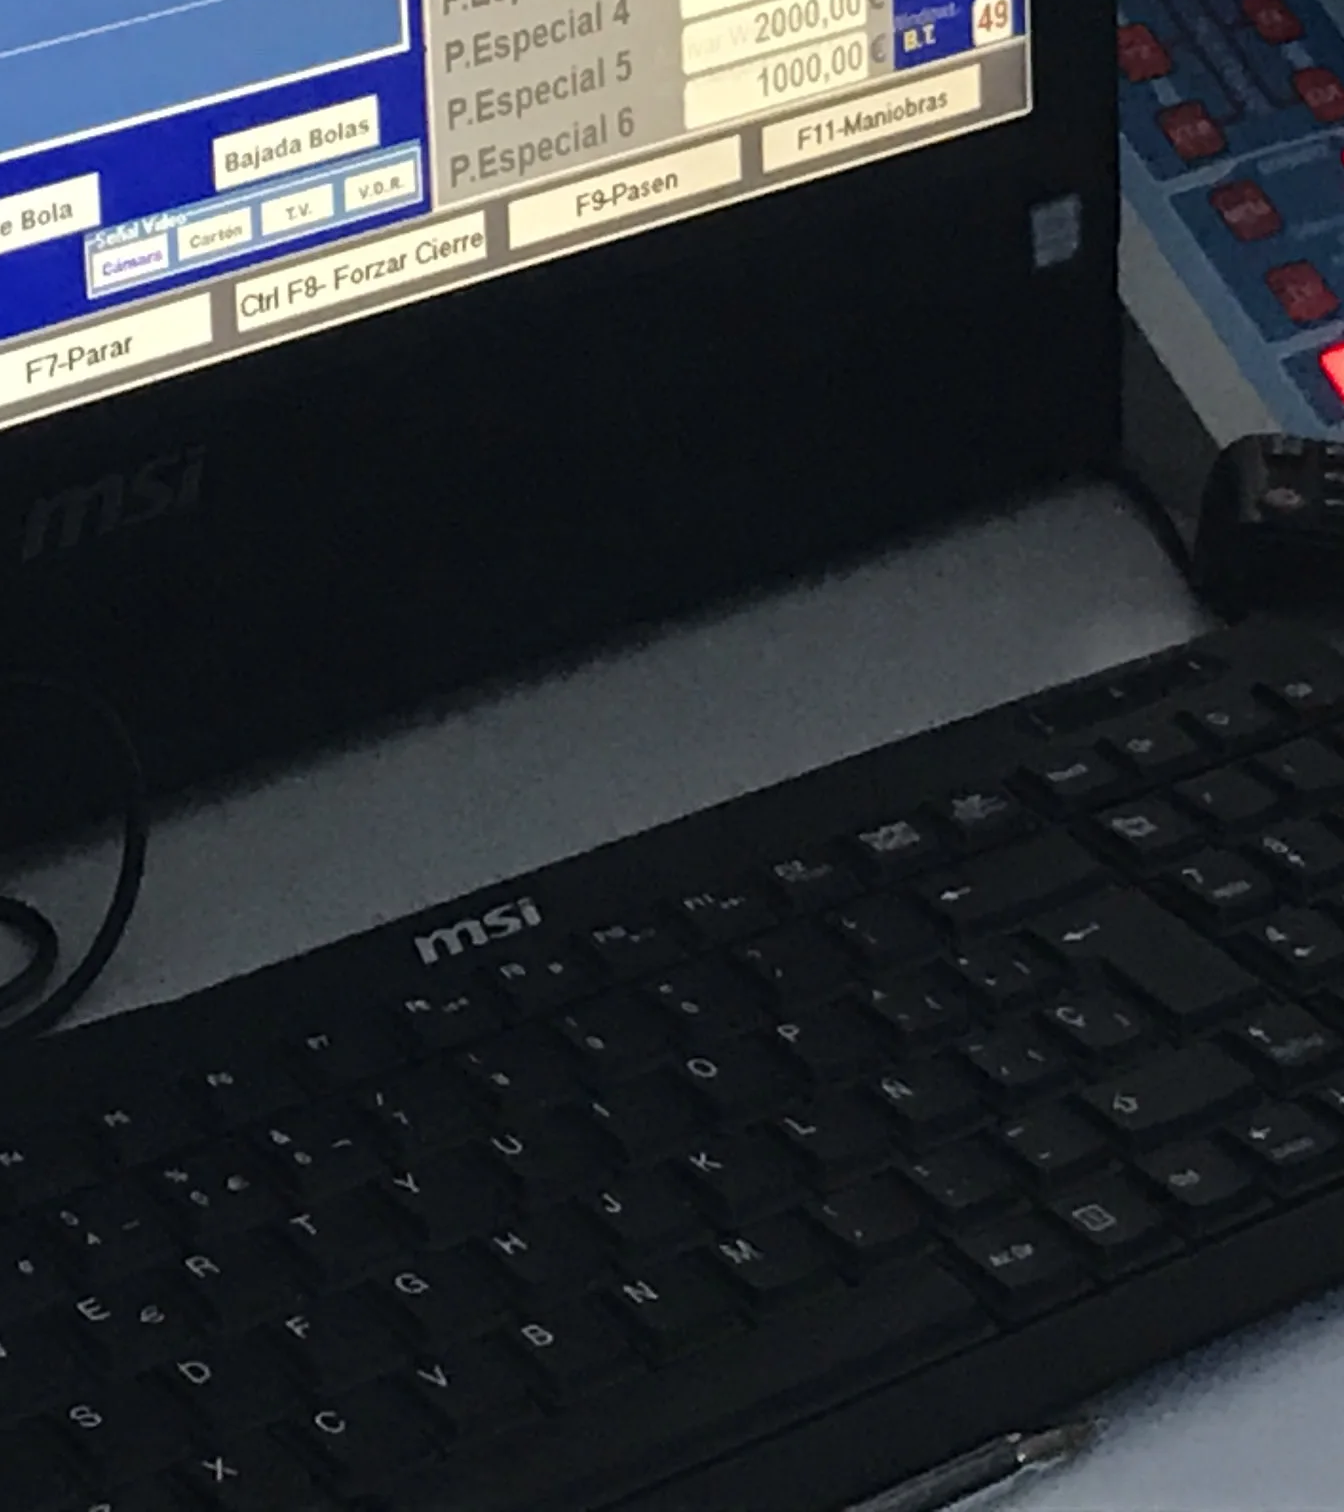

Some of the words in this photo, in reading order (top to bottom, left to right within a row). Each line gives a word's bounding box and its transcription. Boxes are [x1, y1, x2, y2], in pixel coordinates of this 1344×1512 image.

[449, 119, 609, 189] P.Especial
[617, 106, 635, 139] 6
[757, 40, 864, 99] 1000,00
[797, 88, 949, 151] F11-Maniobras
[224, 136, 302, 175] Bajada
[308, 116, 370, 151] Bolas
[20, 197, 74, 236] Bola
[575, 170, 678, 217] F9-Pasen
[240, 288, 281, 320] Ctrl
[333, 251, 408, 291] Forzar
[415, 227, 484, 265] Cierre
[24, 331, 135, 385] F7-Parar
[414, 897, 541, 964] msi
[76, 1295, 111, 1323] E
[520, 1322, 555, 1348] B
